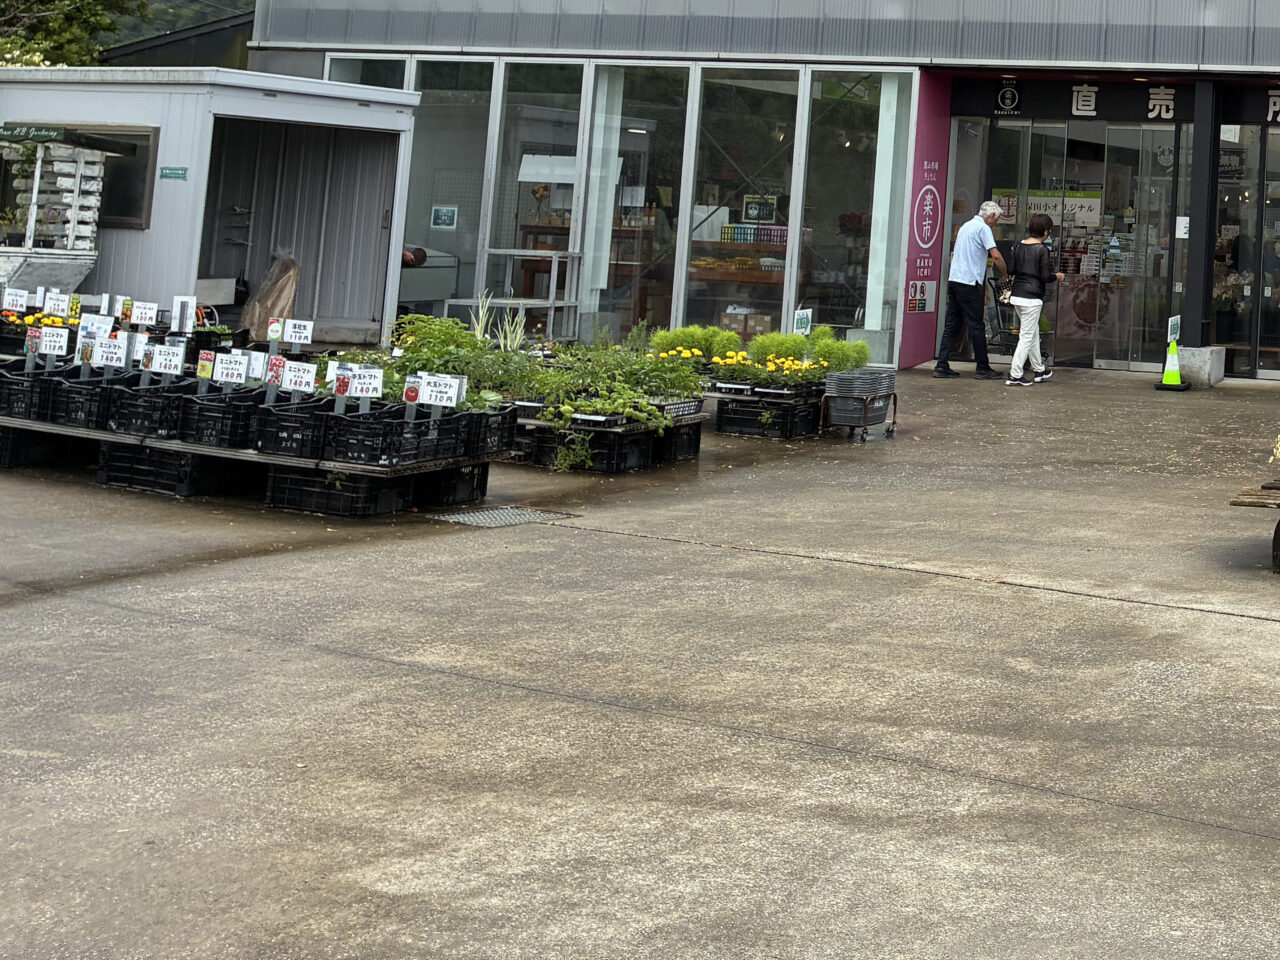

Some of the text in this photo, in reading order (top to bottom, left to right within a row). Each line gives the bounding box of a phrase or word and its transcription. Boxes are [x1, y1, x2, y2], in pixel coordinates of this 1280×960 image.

[922, 192, 934, 241] 楽市
[916, 258, 933, 267] RAKU
[43, 331, 64, 339] ミニトマト
[44, 343, 63, 352] 110円
[99, 342, 122, 351] ミニトマト
[158, 349, 180, 358] ミニトマト
[220, 358, 243, 366] ミニトマト
[288, 365, 311, 374] ミニトマト
[220, 371, 242, 380] 140円
[289, 379, 311, 388] 140円
[426, 380, 454, 389] 大玉トマト
[355, 386, 379, 394] 140円
[428, 394, 453, 403] 110円
